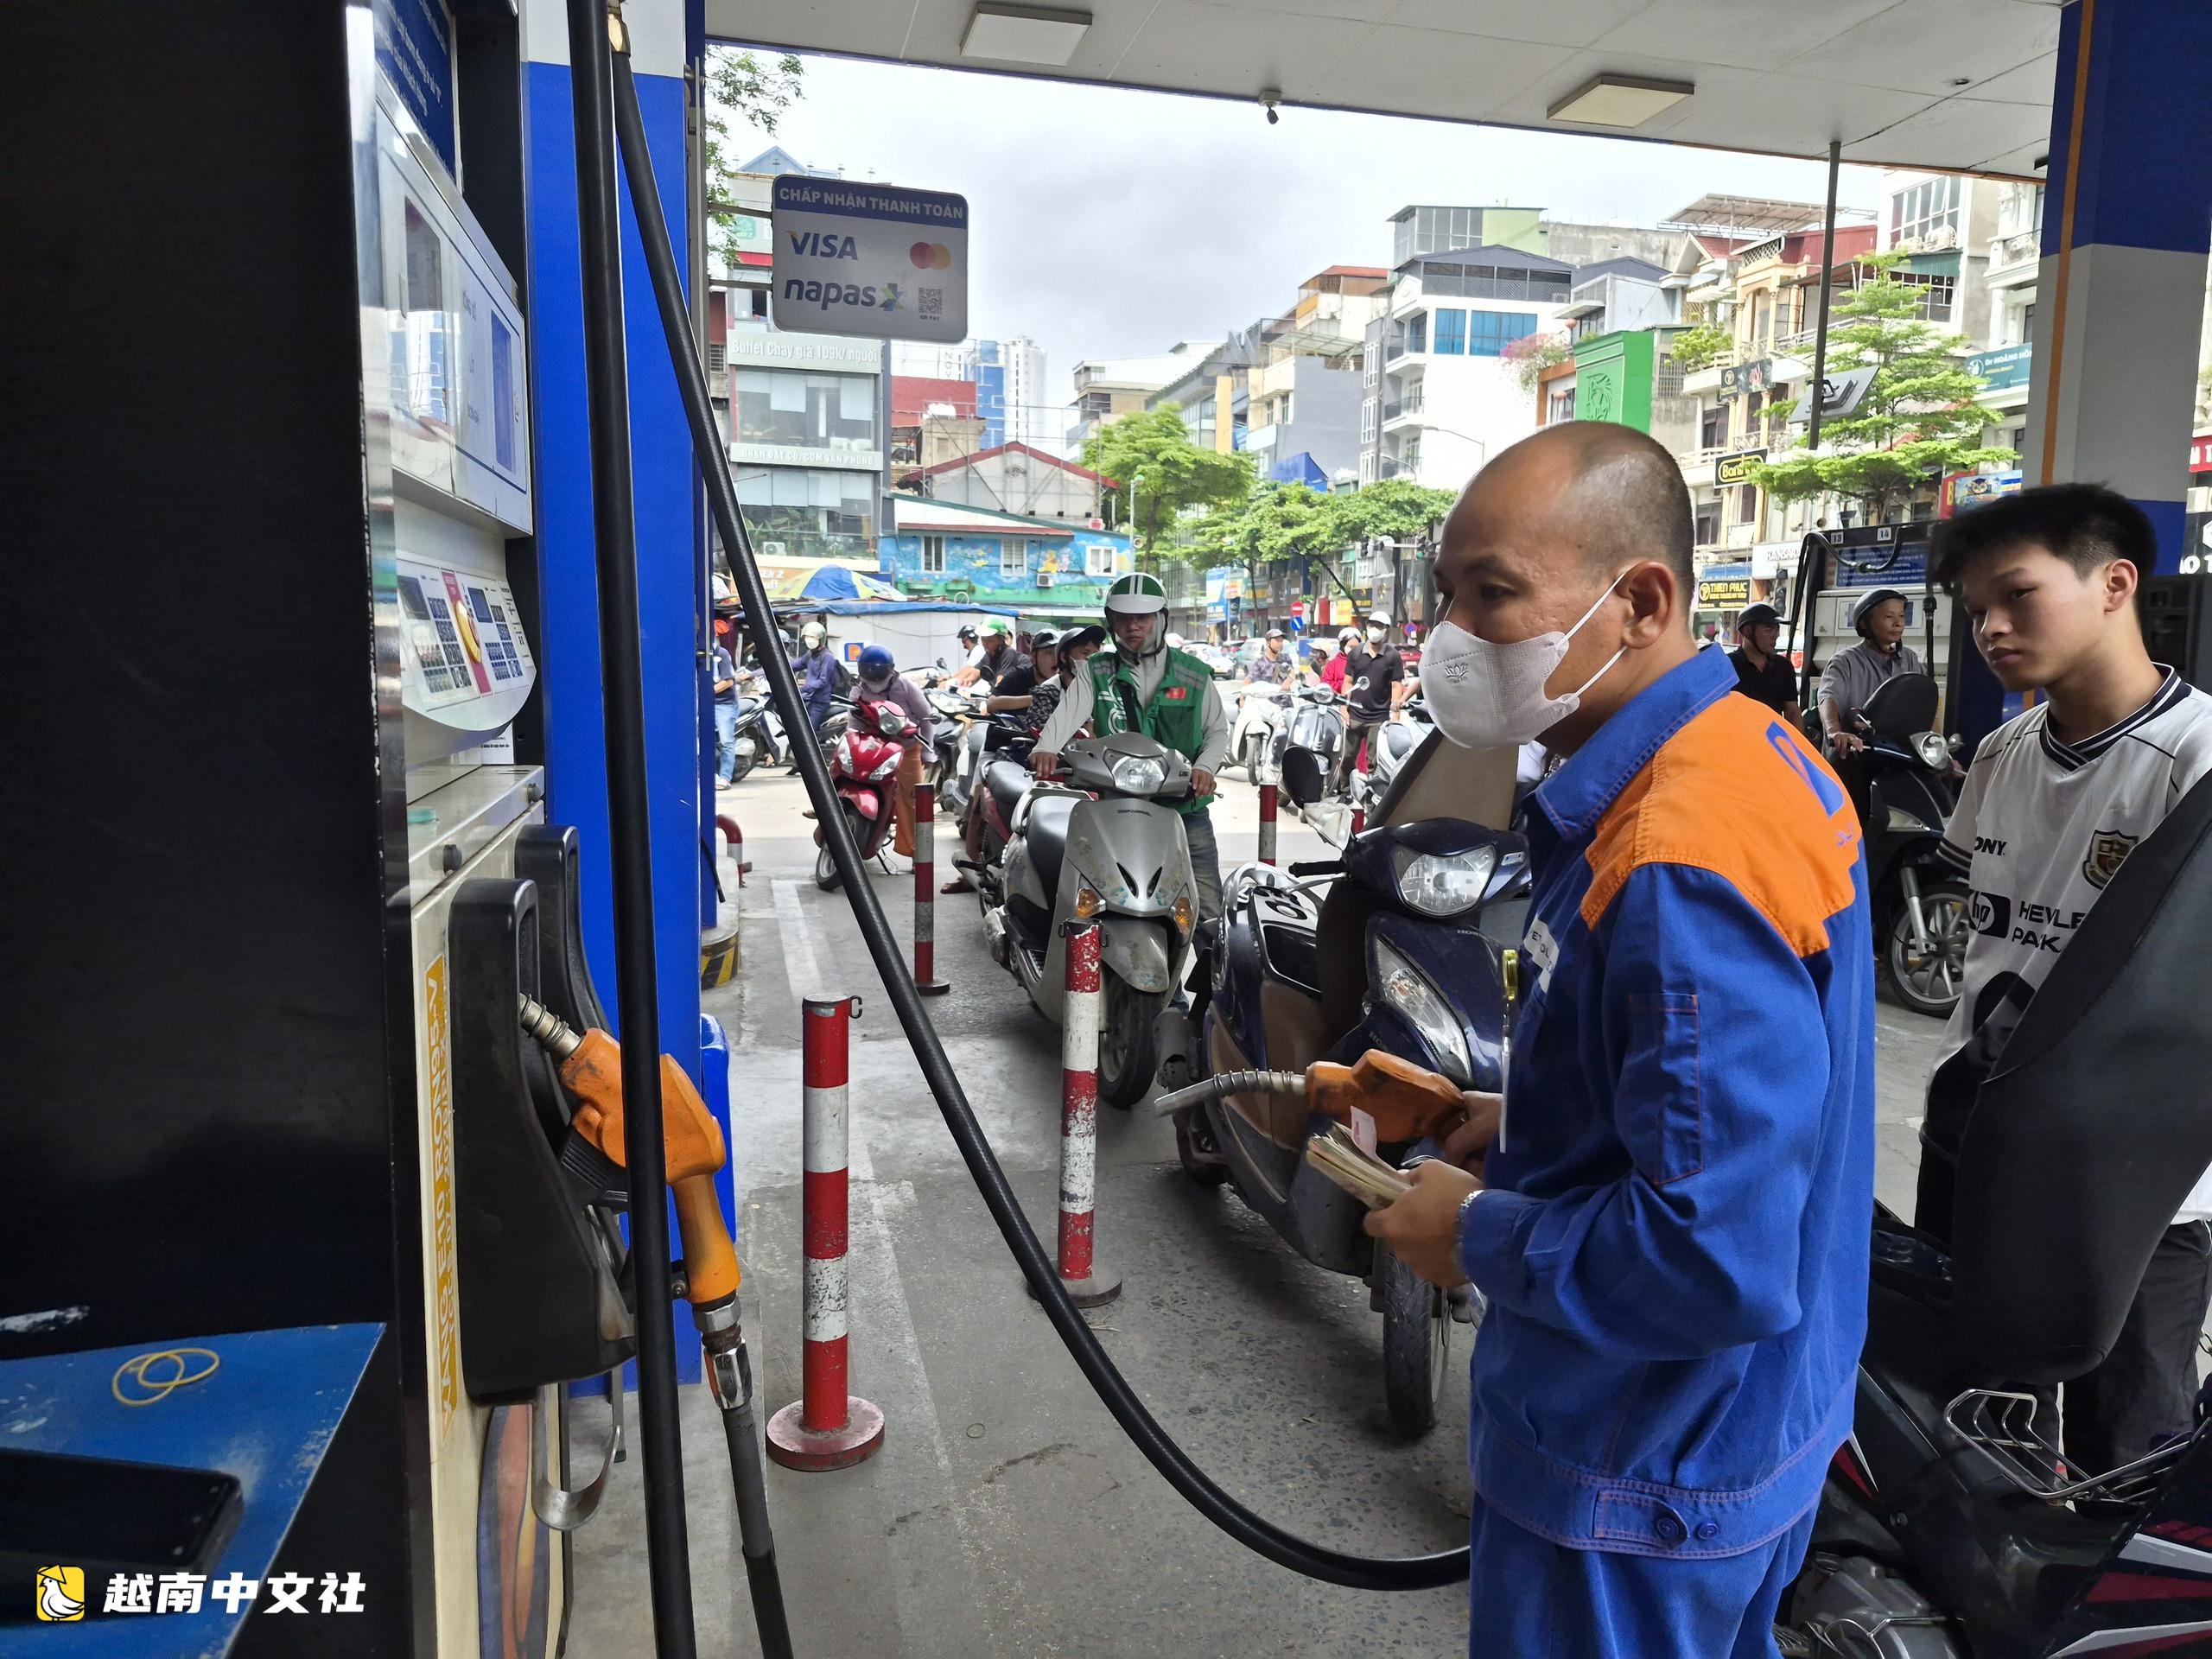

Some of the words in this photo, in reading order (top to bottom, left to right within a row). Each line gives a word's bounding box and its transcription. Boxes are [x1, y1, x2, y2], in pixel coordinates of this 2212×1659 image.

[779, 187, 821, 203] CHẤP
[823, 192, 866, 210] NHẬN
[869, 197, 920, 214] THANH
[924, 203, 963, 219] TOÁN
[785, 230, 858, 261] VISA
[784, 279, 877, 311] napas
[767, 342, 795, 359] Chay
[1833, 534, 1842, 543] 13
[1879, 530, 1890, 538] 14
[1974, 836, 2007, 856] ONY
[428, 977, 444, 1183] RON95-V
[436, 1191, 448, 1280] E10
